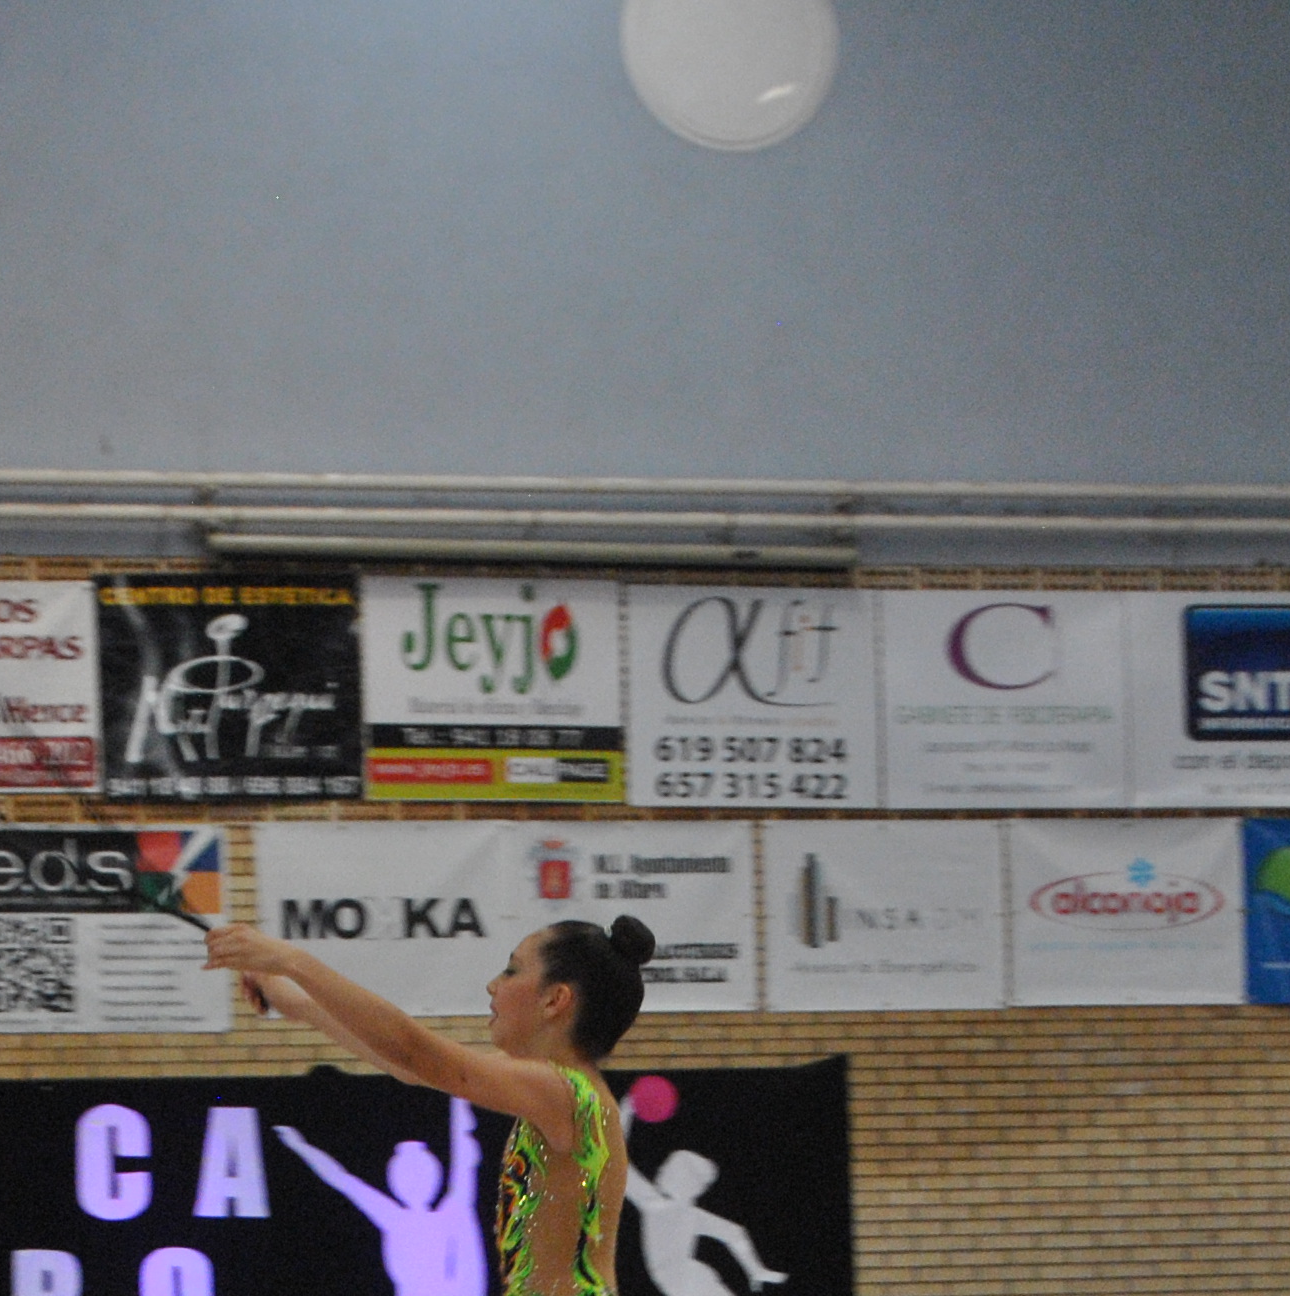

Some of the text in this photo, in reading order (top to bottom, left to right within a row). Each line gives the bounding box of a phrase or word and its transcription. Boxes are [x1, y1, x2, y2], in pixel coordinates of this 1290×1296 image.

[653, 735, 849, 764] 619 507 824
[654, 771, 850, 800] 657 315 422
